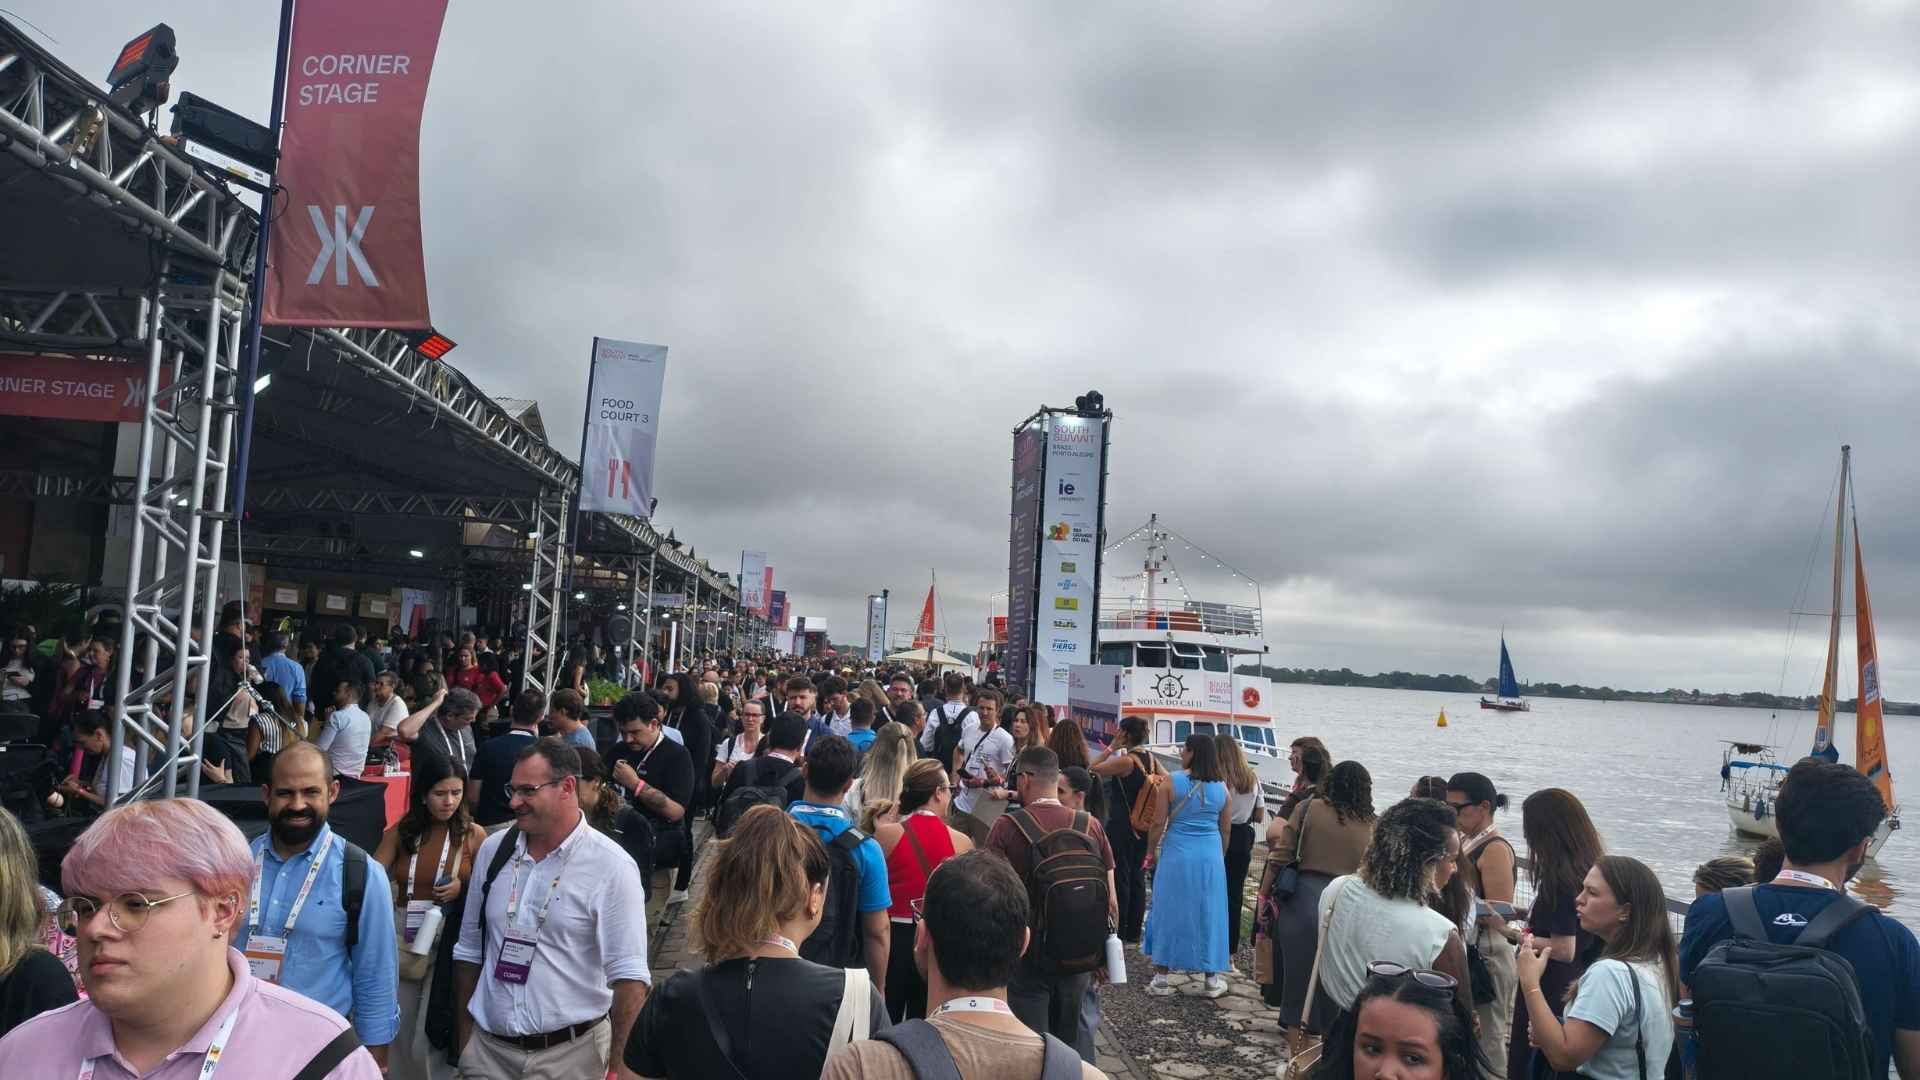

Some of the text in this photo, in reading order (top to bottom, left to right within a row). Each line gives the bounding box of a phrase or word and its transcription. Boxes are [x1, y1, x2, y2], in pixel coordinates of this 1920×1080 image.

[302, 54, 410, 76] CORNER
[299, 83, 379, 106] STAGE
[50, 380, 115, 399] STAGE
[601, 398, 634, 410] FOOD
[600, 410, 649, 424] COURT 3
[1058, 478, 1075, 496] ie
